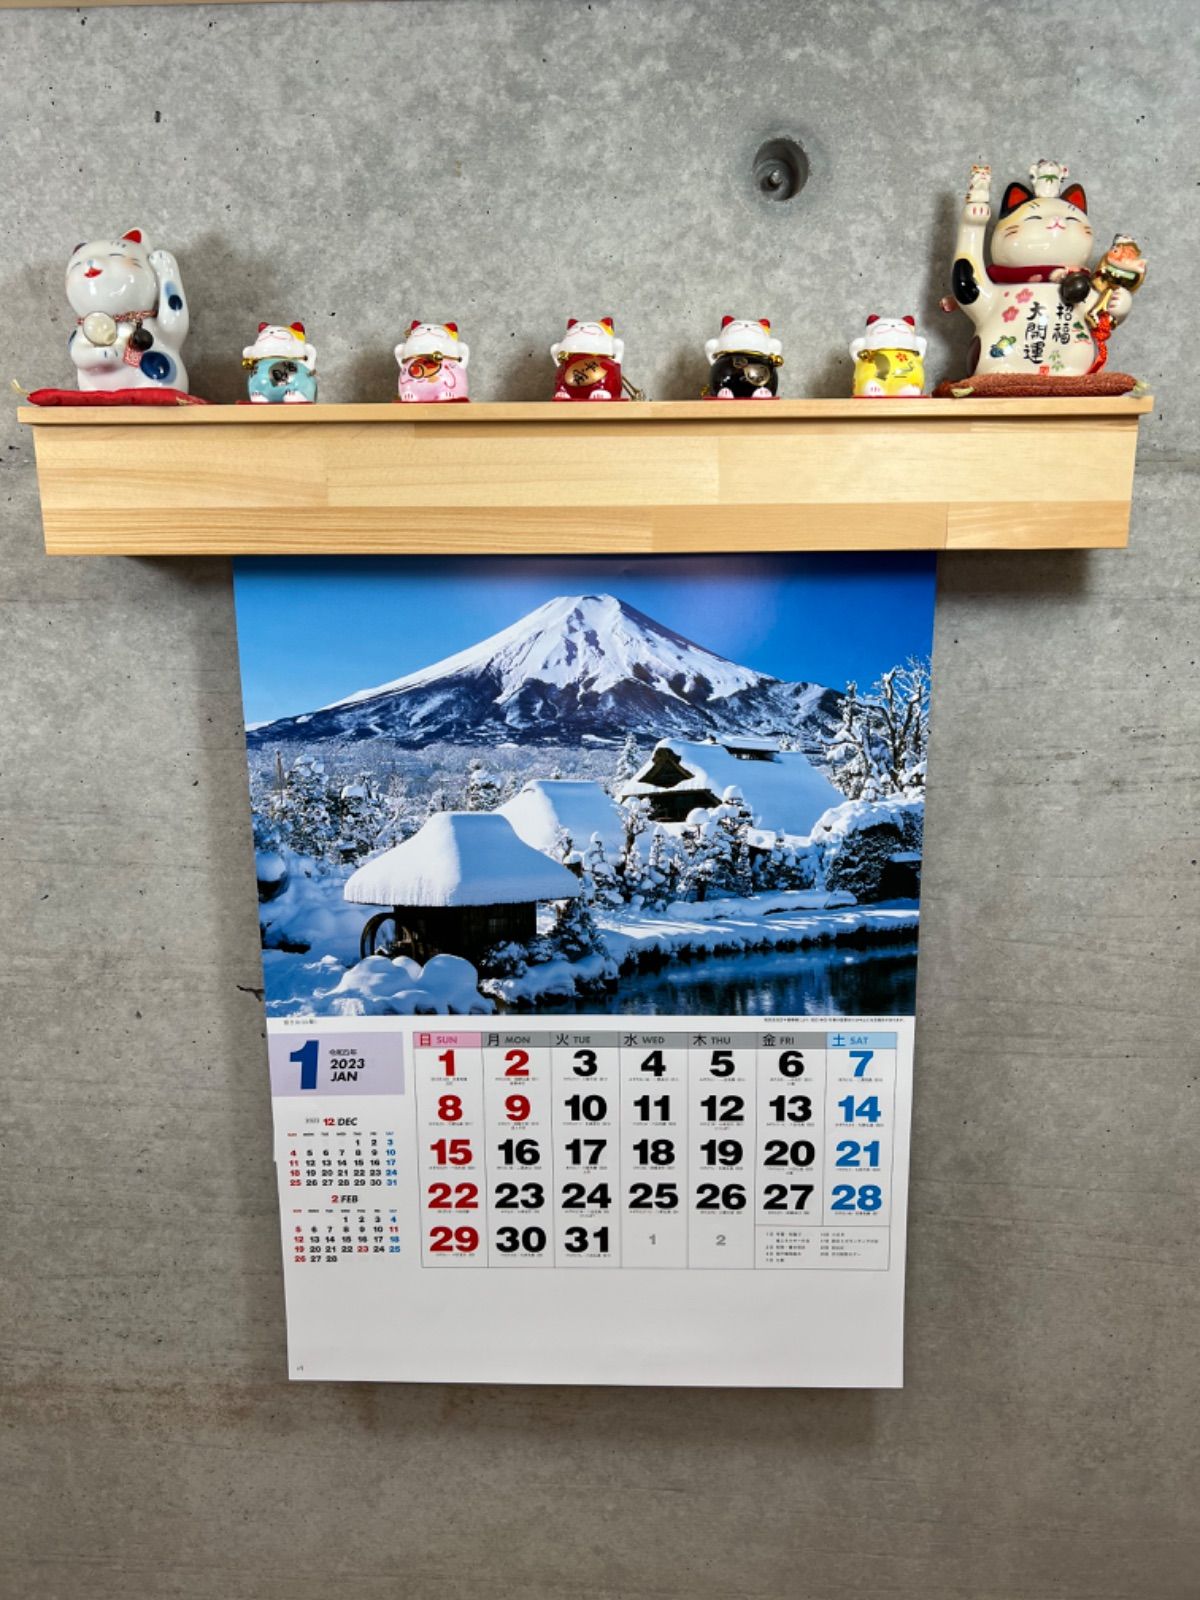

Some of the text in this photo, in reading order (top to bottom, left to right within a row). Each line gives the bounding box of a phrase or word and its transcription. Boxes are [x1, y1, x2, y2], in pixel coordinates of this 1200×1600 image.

[420, 1033, 458, 1046] 日 SUN
[488, 1033, 531, 1046] 月 MON
[557, 1033, 591, 1046] 火 TUE
[624, 1033, 665, 1046] 水 WED
[693, 1033, 731, 1046] 木 THU
[763, 1033, 795, 1046] 金 FRI
[832, 1034, 868, 1046] 土 SAT
[290, 1040, 319, 1090] 1
[330, 1058, 365, 1070] 2023
[439, 1049, 873, 1077] 1 2 3 4 5 6 7
[330, 1070, 358, 1082] JAN
[438, 1095, 881, 1122] 8 9 10 11 12 13 14
[323, 1117, 336, 1127] 12
[337, 1116, 358, 1127] DEC
[385, 1148, 396, 1157] 10
[430, 1139, 879, 1167] 15 16 17 18 19 20 21
[321, 1159, 332, 1167] 13
[385, 1158, 397, 1166] 17
[305, 1169, 317, 1177] 19
[321, 1169, 334, 1177] 20
[337, 1169, 349, 1177] 21
[353, 1168, 366, 1177] 22
[369, 1169, 382, 1177] 23
[385, 1169, 398, 1177] 24
[305, 1178, 318, 1187] 26
[321, 1178, 334, 1187] 27
[353, 1178, 366, 1187] 29
[369, 1178, 383, 1187] 30
[386, 1178, 398, 1187] 31
[330, 1194, 359, 1204] 2 FEB
[428, 1183, 882, 1211] 22 23 24 25 26 27 28
[309, 1235, 320, 1244] 13
[357, 1235, 368, 1244] 16
[373, 1235, 384, 1243] 17
[430, 1226, 727, 1253] 29 30 31 1 2
[294, 1245, 305, 1253] 19
[309, 1245, 322, 1254] 20
[324, 1245, 336, 1254] 21
[340, 1245, 354, 1253] 22
[357, 1245, 369, 1253] 23
[373, 1245, 386, 1253] 24
[294, 1255, 307, 1263] 26
[310, 1254, 322, 1263] 27
